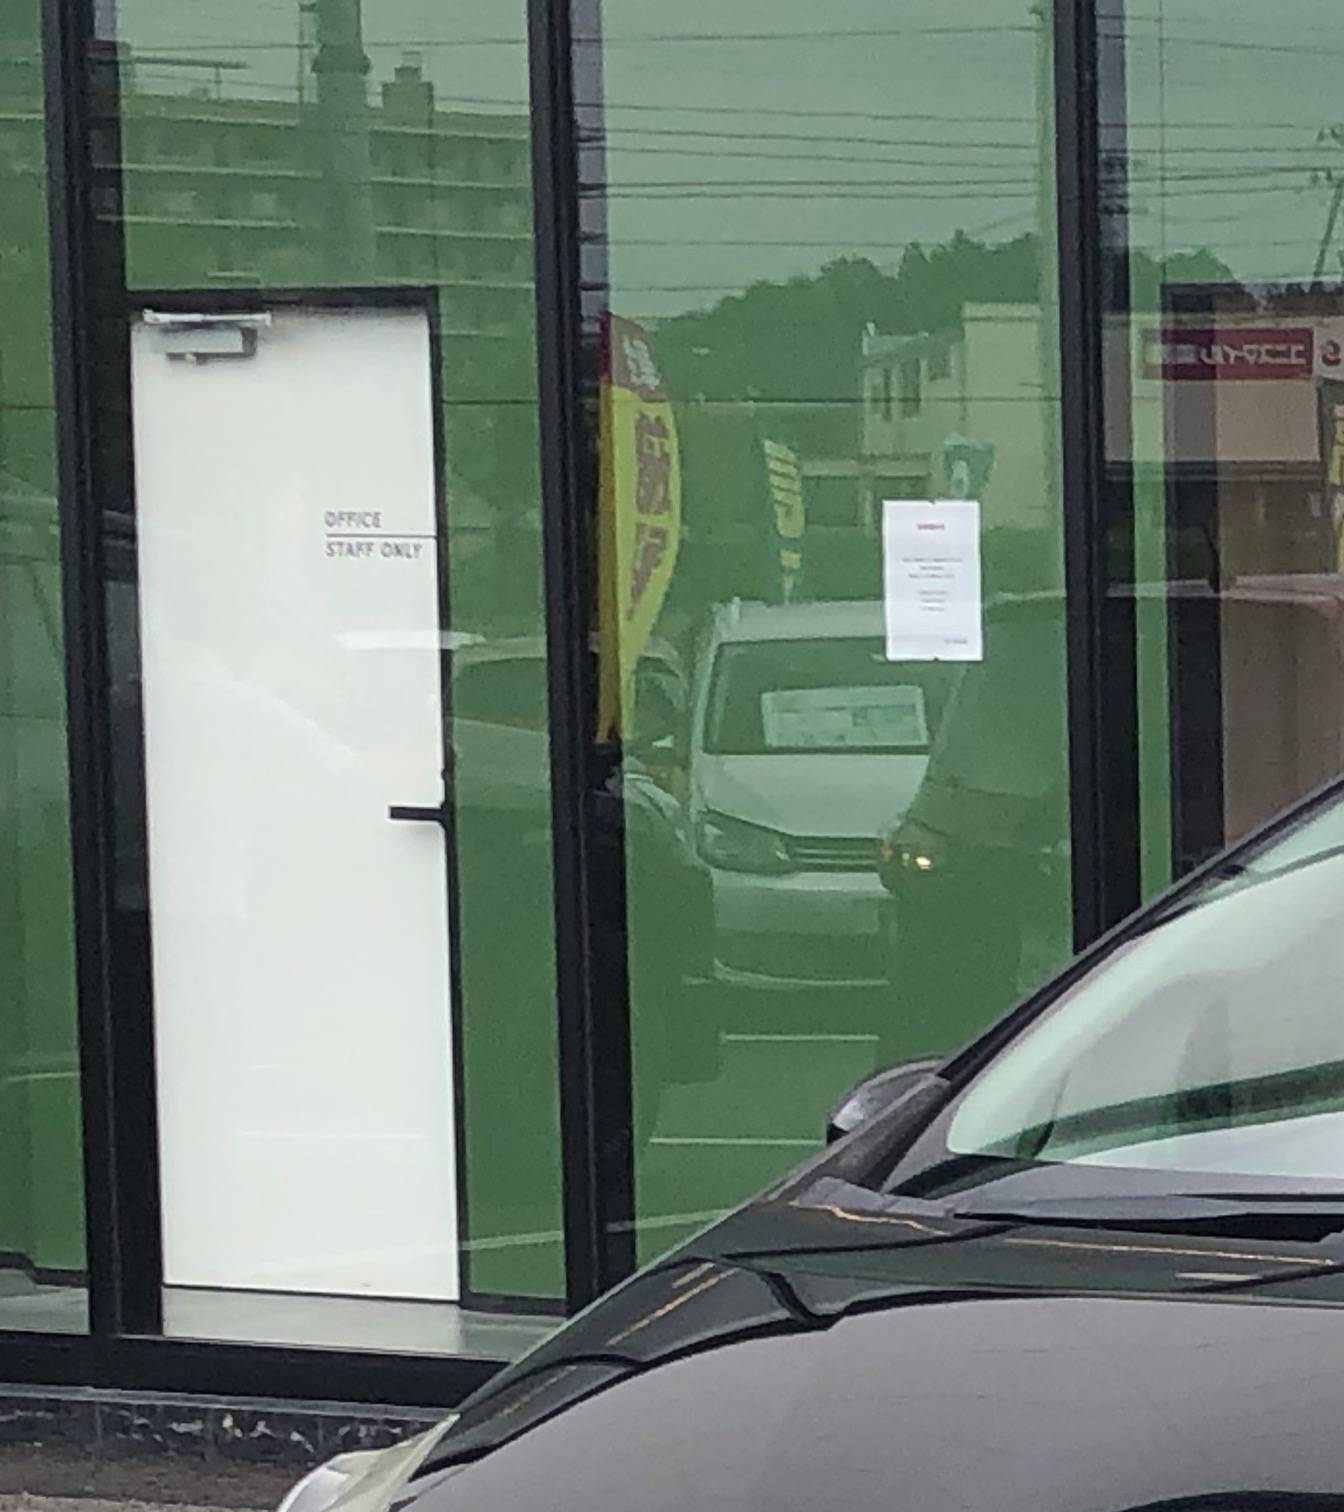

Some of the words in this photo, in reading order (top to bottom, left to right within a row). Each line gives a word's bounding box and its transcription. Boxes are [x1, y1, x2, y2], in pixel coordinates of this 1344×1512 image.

[324, 510, 382, 529] OFFICE
[325, 541, 375, 558] STAFF
[380, 542, 423, 560] ONLY
